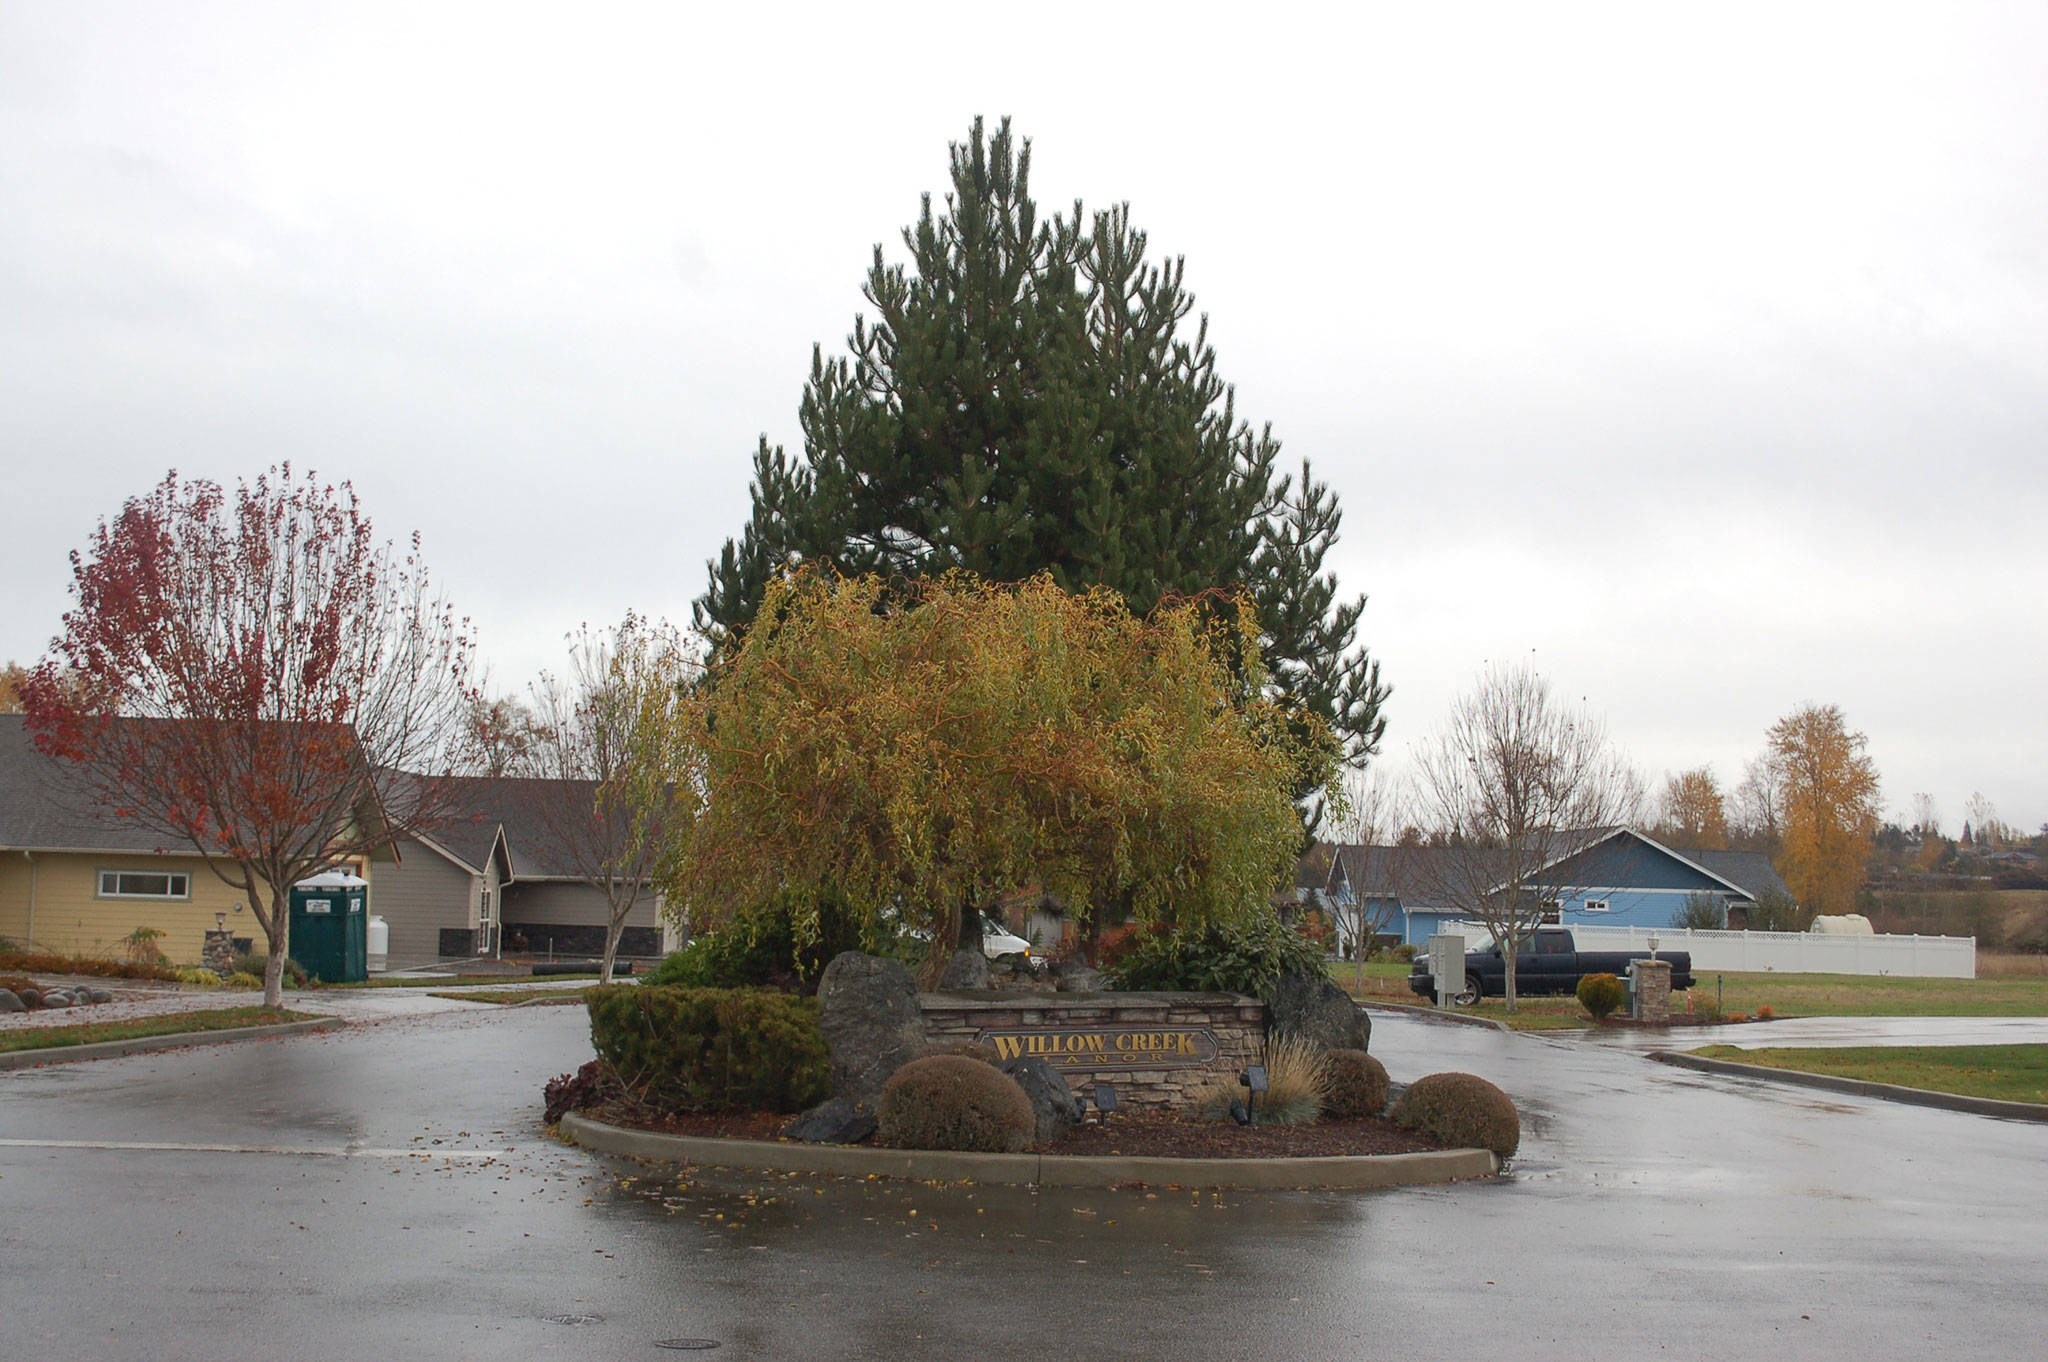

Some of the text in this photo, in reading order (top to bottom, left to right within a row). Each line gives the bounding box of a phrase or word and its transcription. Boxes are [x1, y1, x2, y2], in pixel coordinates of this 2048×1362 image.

[992, 1032, 1199, 1060] WILLOW CREEK
[1043, 1054, 1164, 1064] ANOR
